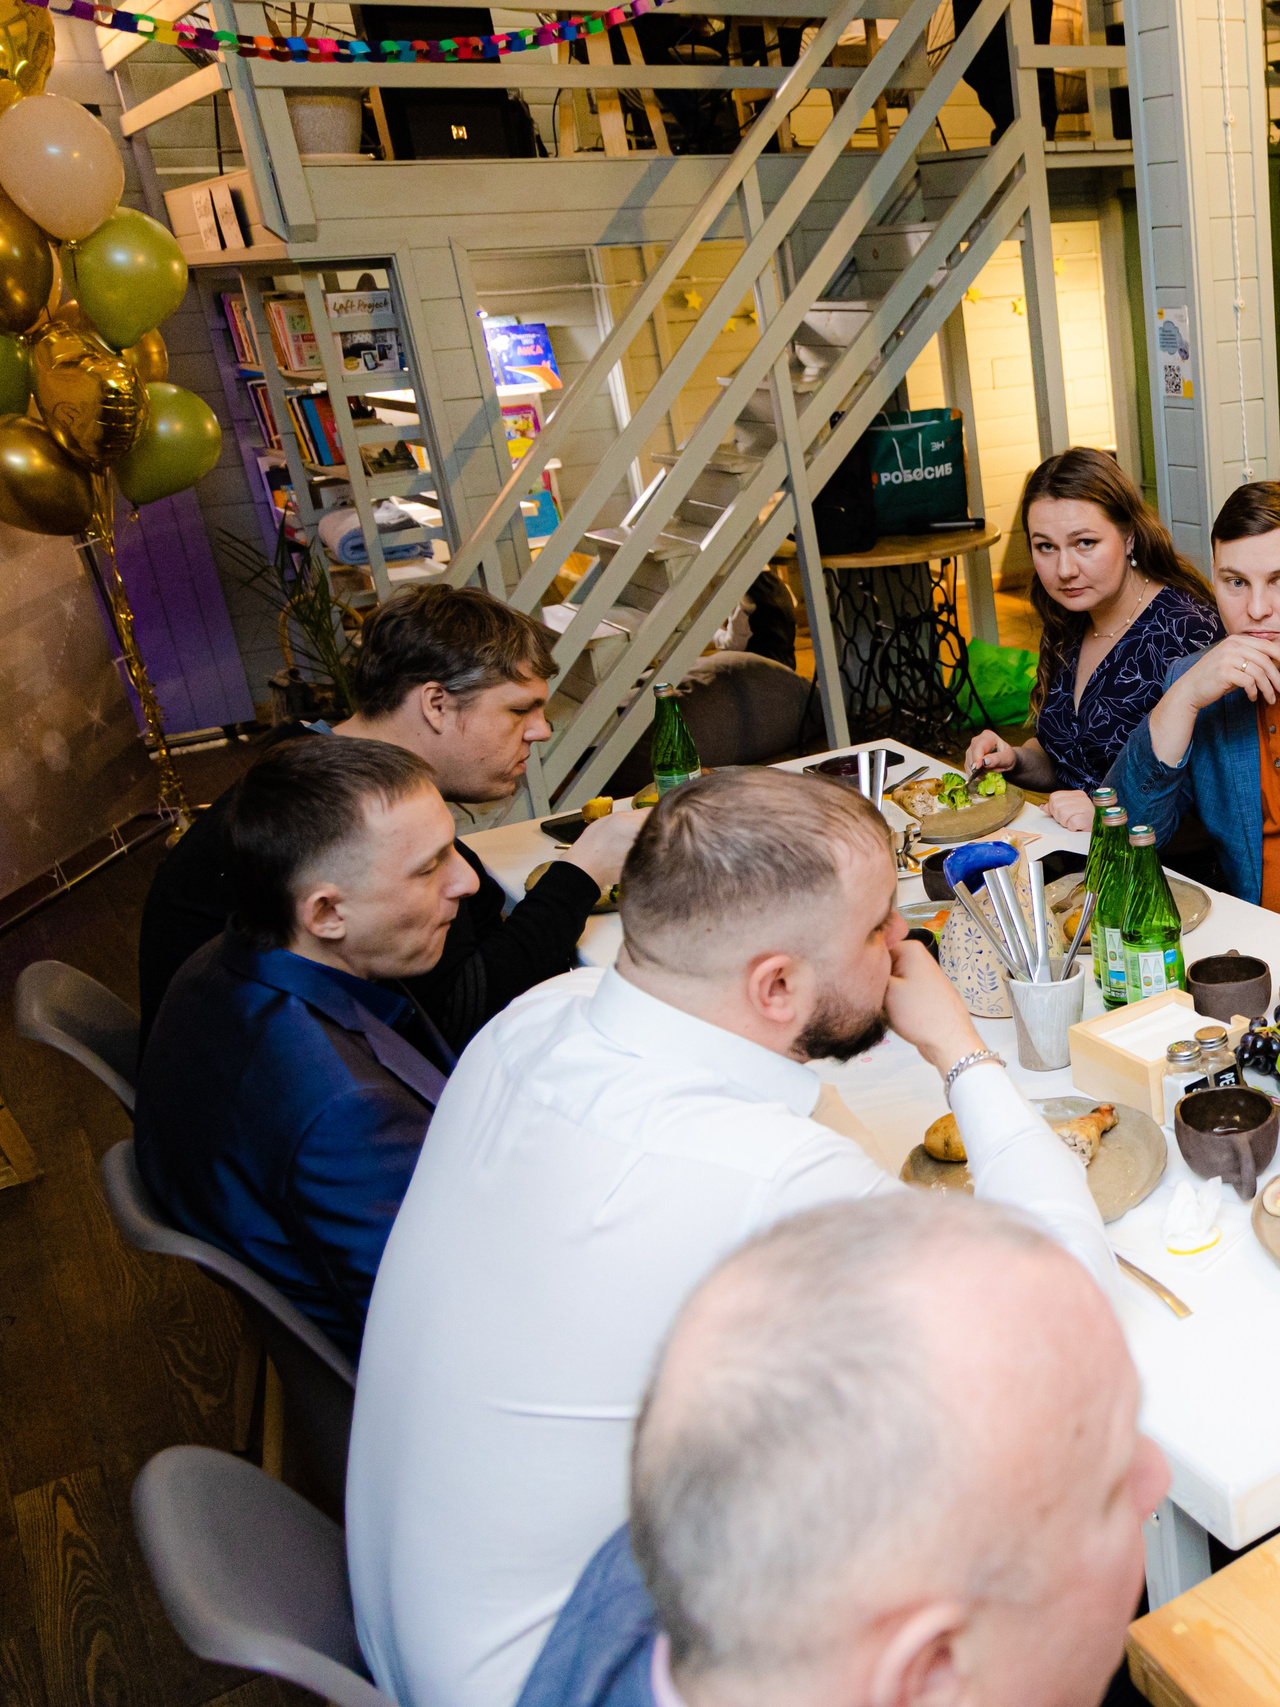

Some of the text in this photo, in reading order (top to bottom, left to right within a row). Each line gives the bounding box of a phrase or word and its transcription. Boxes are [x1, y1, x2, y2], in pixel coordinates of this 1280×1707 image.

[333, 297, 390, 314] Loft Project
[880, 462, 953, 486] РОБОСИБ
